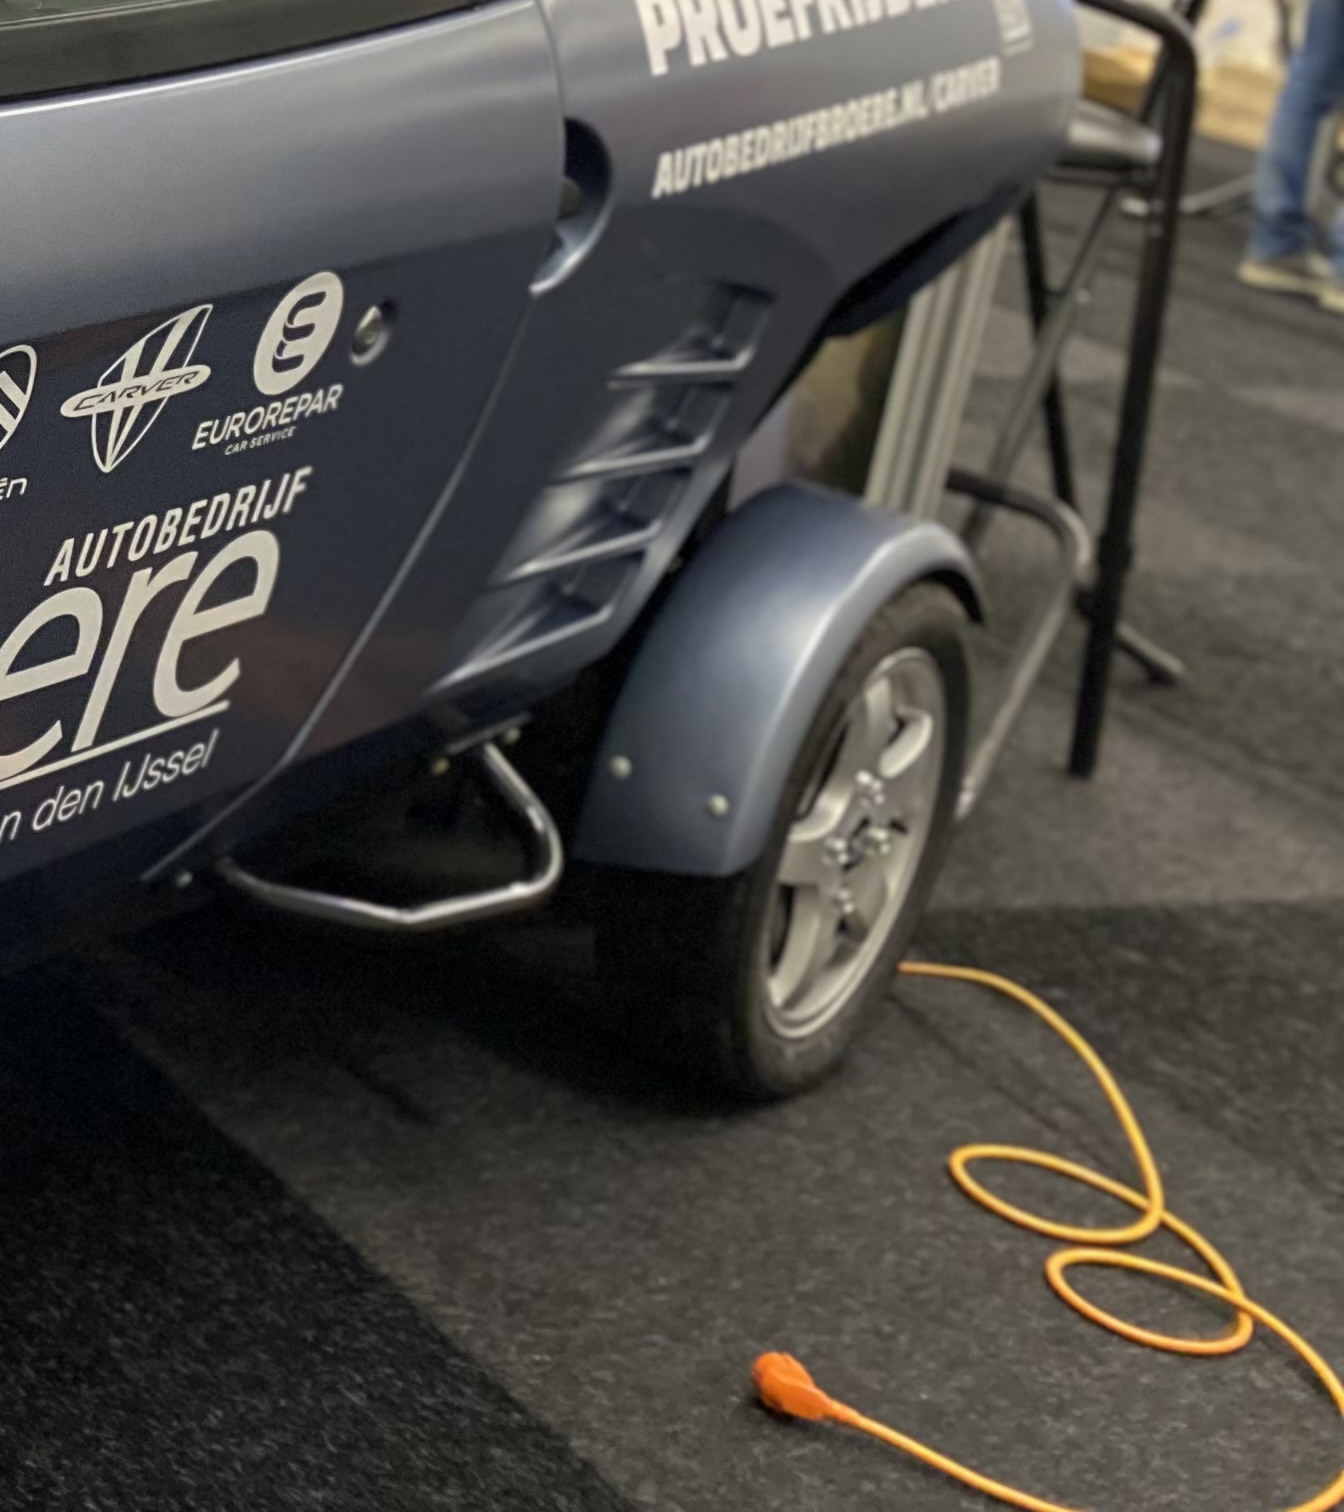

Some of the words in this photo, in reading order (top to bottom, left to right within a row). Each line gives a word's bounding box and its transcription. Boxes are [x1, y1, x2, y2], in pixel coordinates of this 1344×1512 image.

[72, 369, 199, 413] CARVER
[192, 383, 344, 451] EUROREPAR
[224, 439, 248, 456] CAR
[249, 425, 296, 451] SERVICE
[44, 466, 313, 587] AUTOBEDRIJF
[31, 774, 105, 832] den
[112, 728, 220, 804] IJssel
